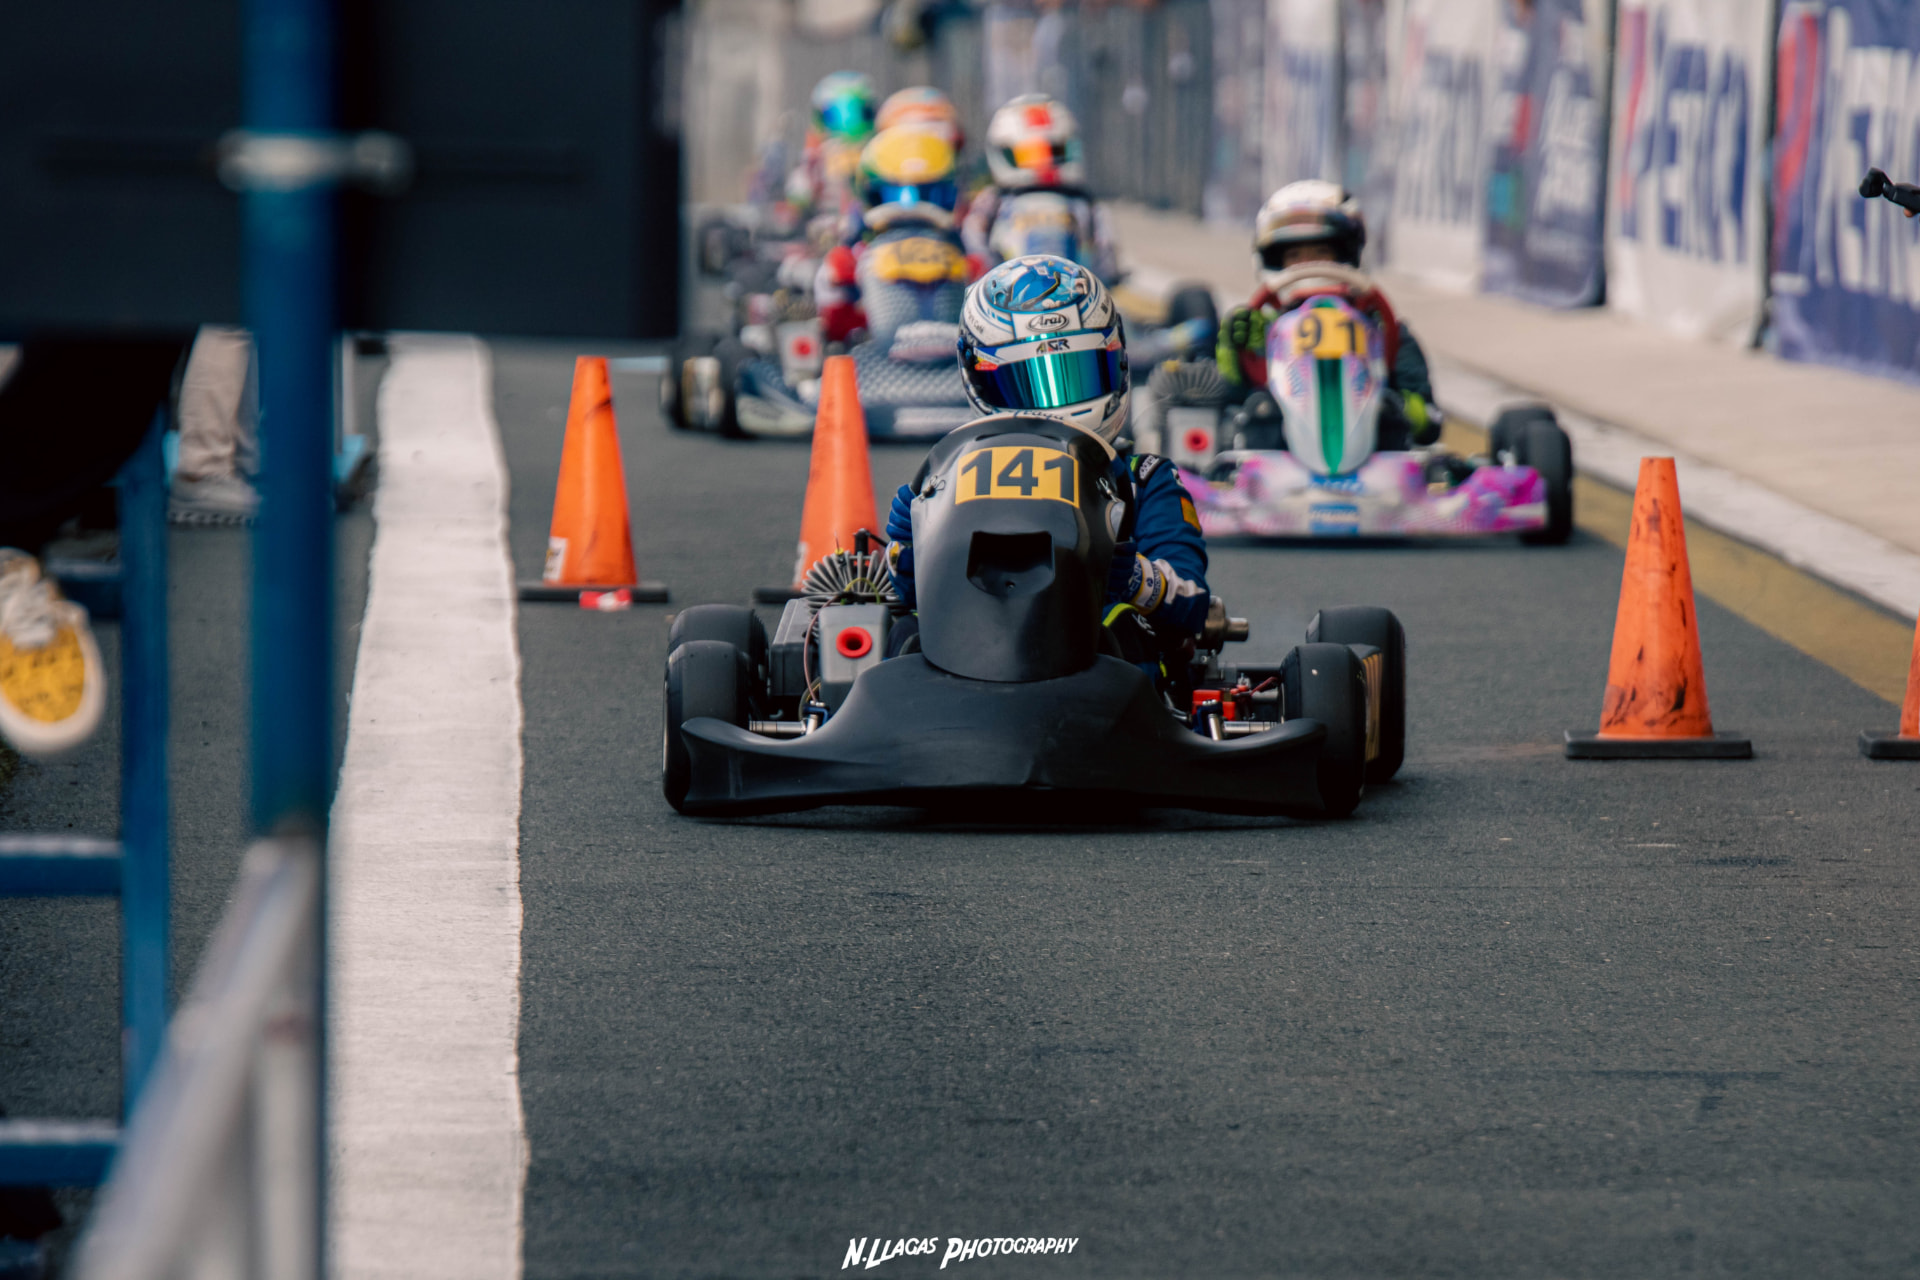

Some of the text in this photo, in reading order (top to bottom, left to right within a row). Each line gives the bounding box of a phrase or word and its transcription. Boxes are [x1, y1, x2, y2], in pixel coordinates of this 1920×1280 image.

[1031, 314, 1062, 327] Arai
[1296, 313, 1357, 354] 91
[960, 448, 1077, 503] 141
